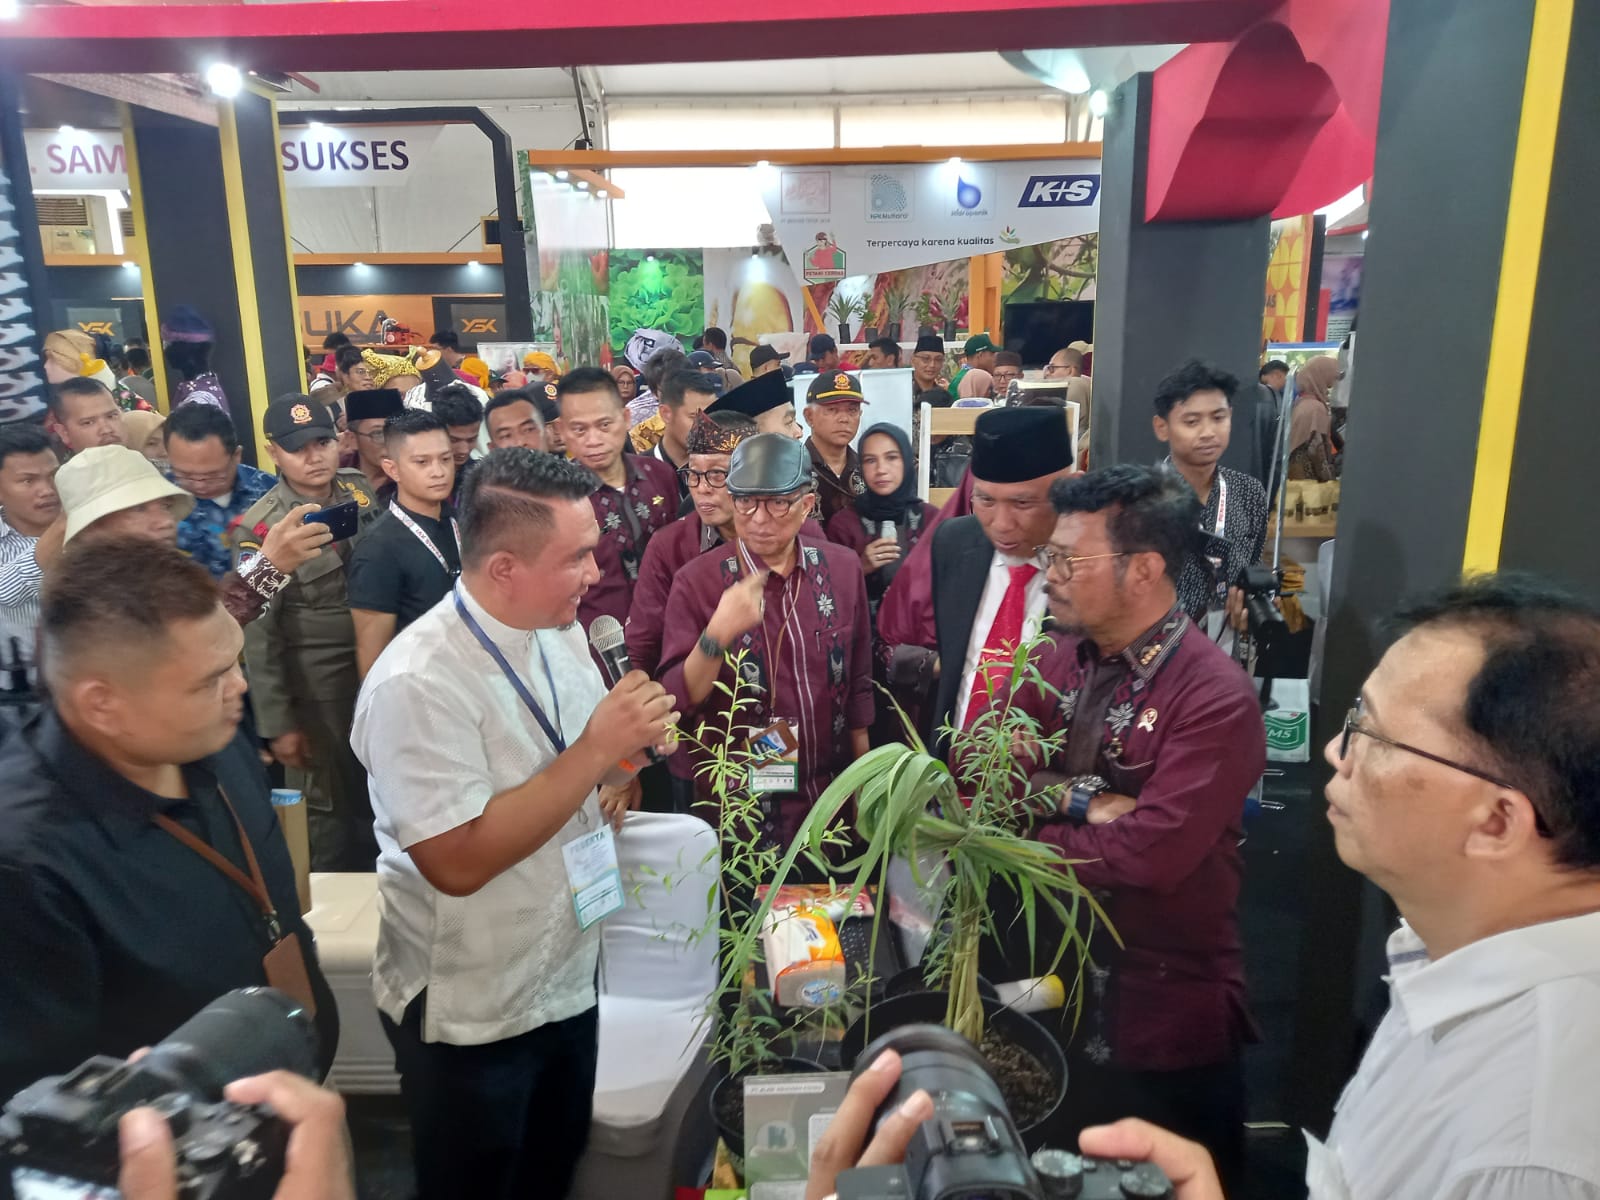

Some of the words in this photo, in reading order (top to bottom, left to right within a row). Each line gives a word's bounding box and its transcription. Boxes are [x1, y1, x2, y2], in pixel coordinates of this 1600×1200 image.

[281, 140, 409, 171] SUKSES
[1029, 180, 1093, 201] K+S
[867, 240, 919, 248] Terpercaya
[922, 238, 955, 246] karena
[958, 236, 994, 245] kualitas
